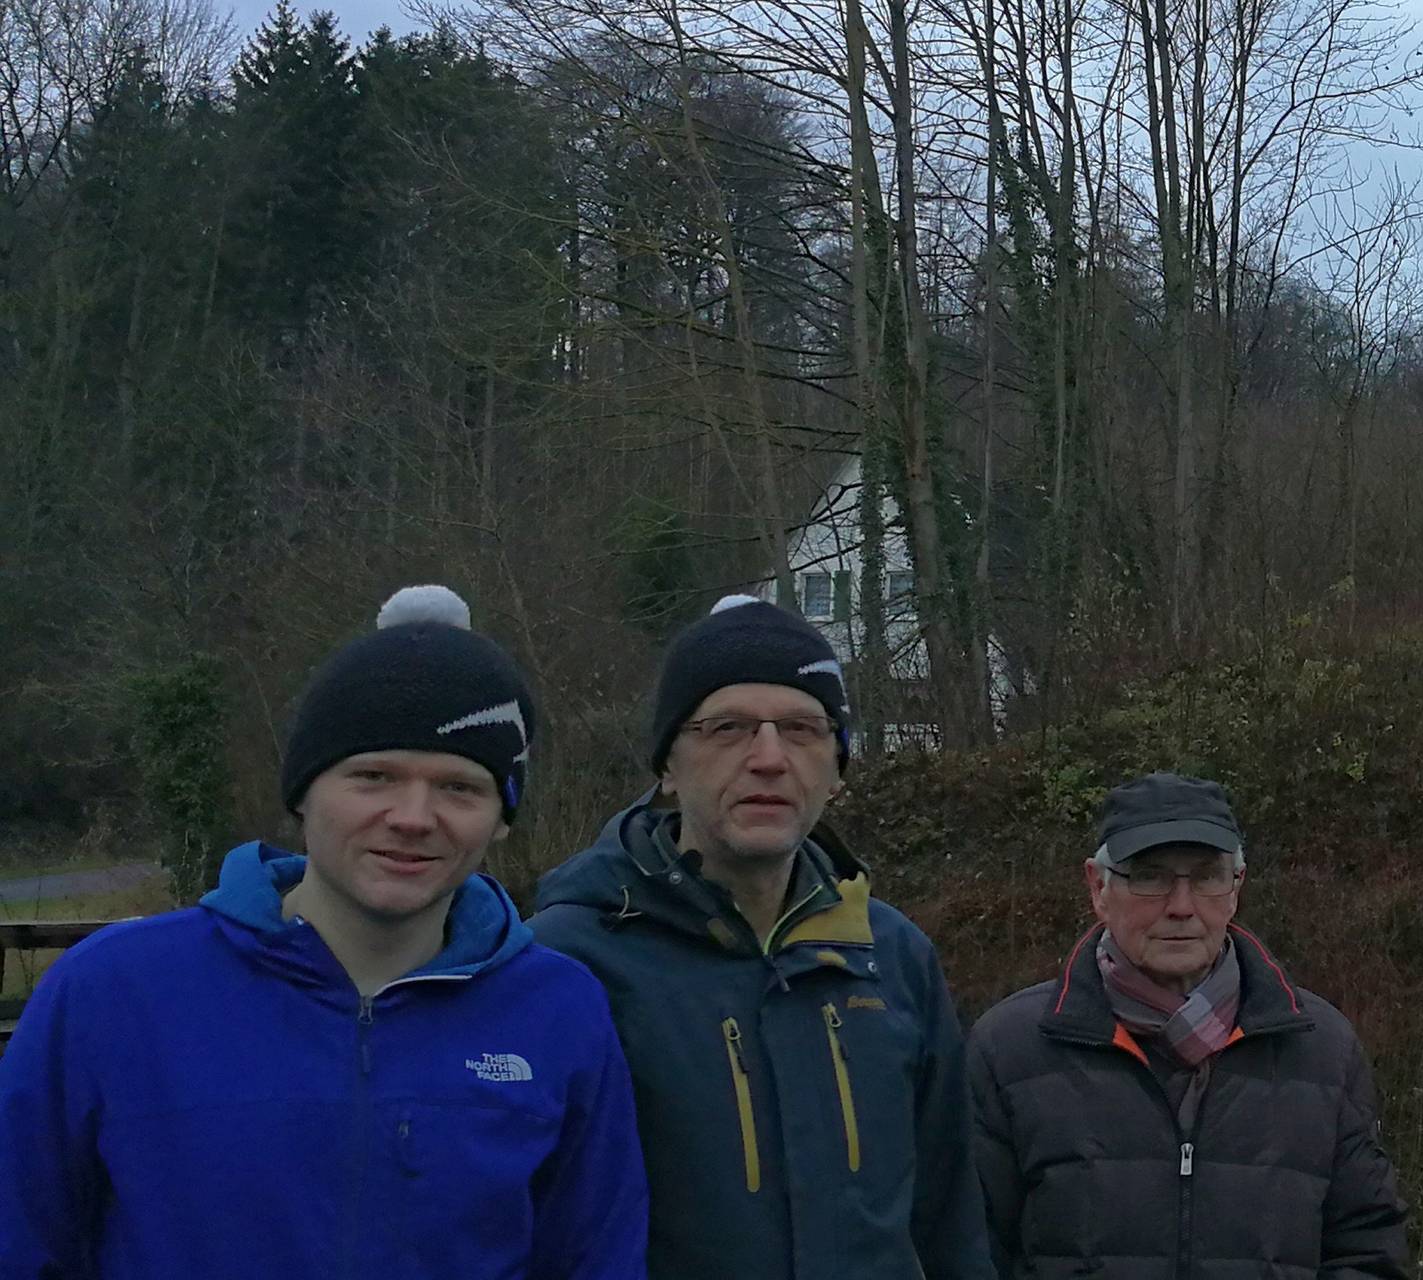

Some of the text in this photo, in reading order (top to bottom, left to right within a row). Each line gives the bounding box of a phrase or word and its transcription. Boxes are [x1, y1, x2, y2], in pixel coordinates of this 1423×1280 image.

[482, 1053, 507, 1063] THE
[465, 1059, 508, 1072] NORTH
[477, 1071, 508, 1081] FACE
